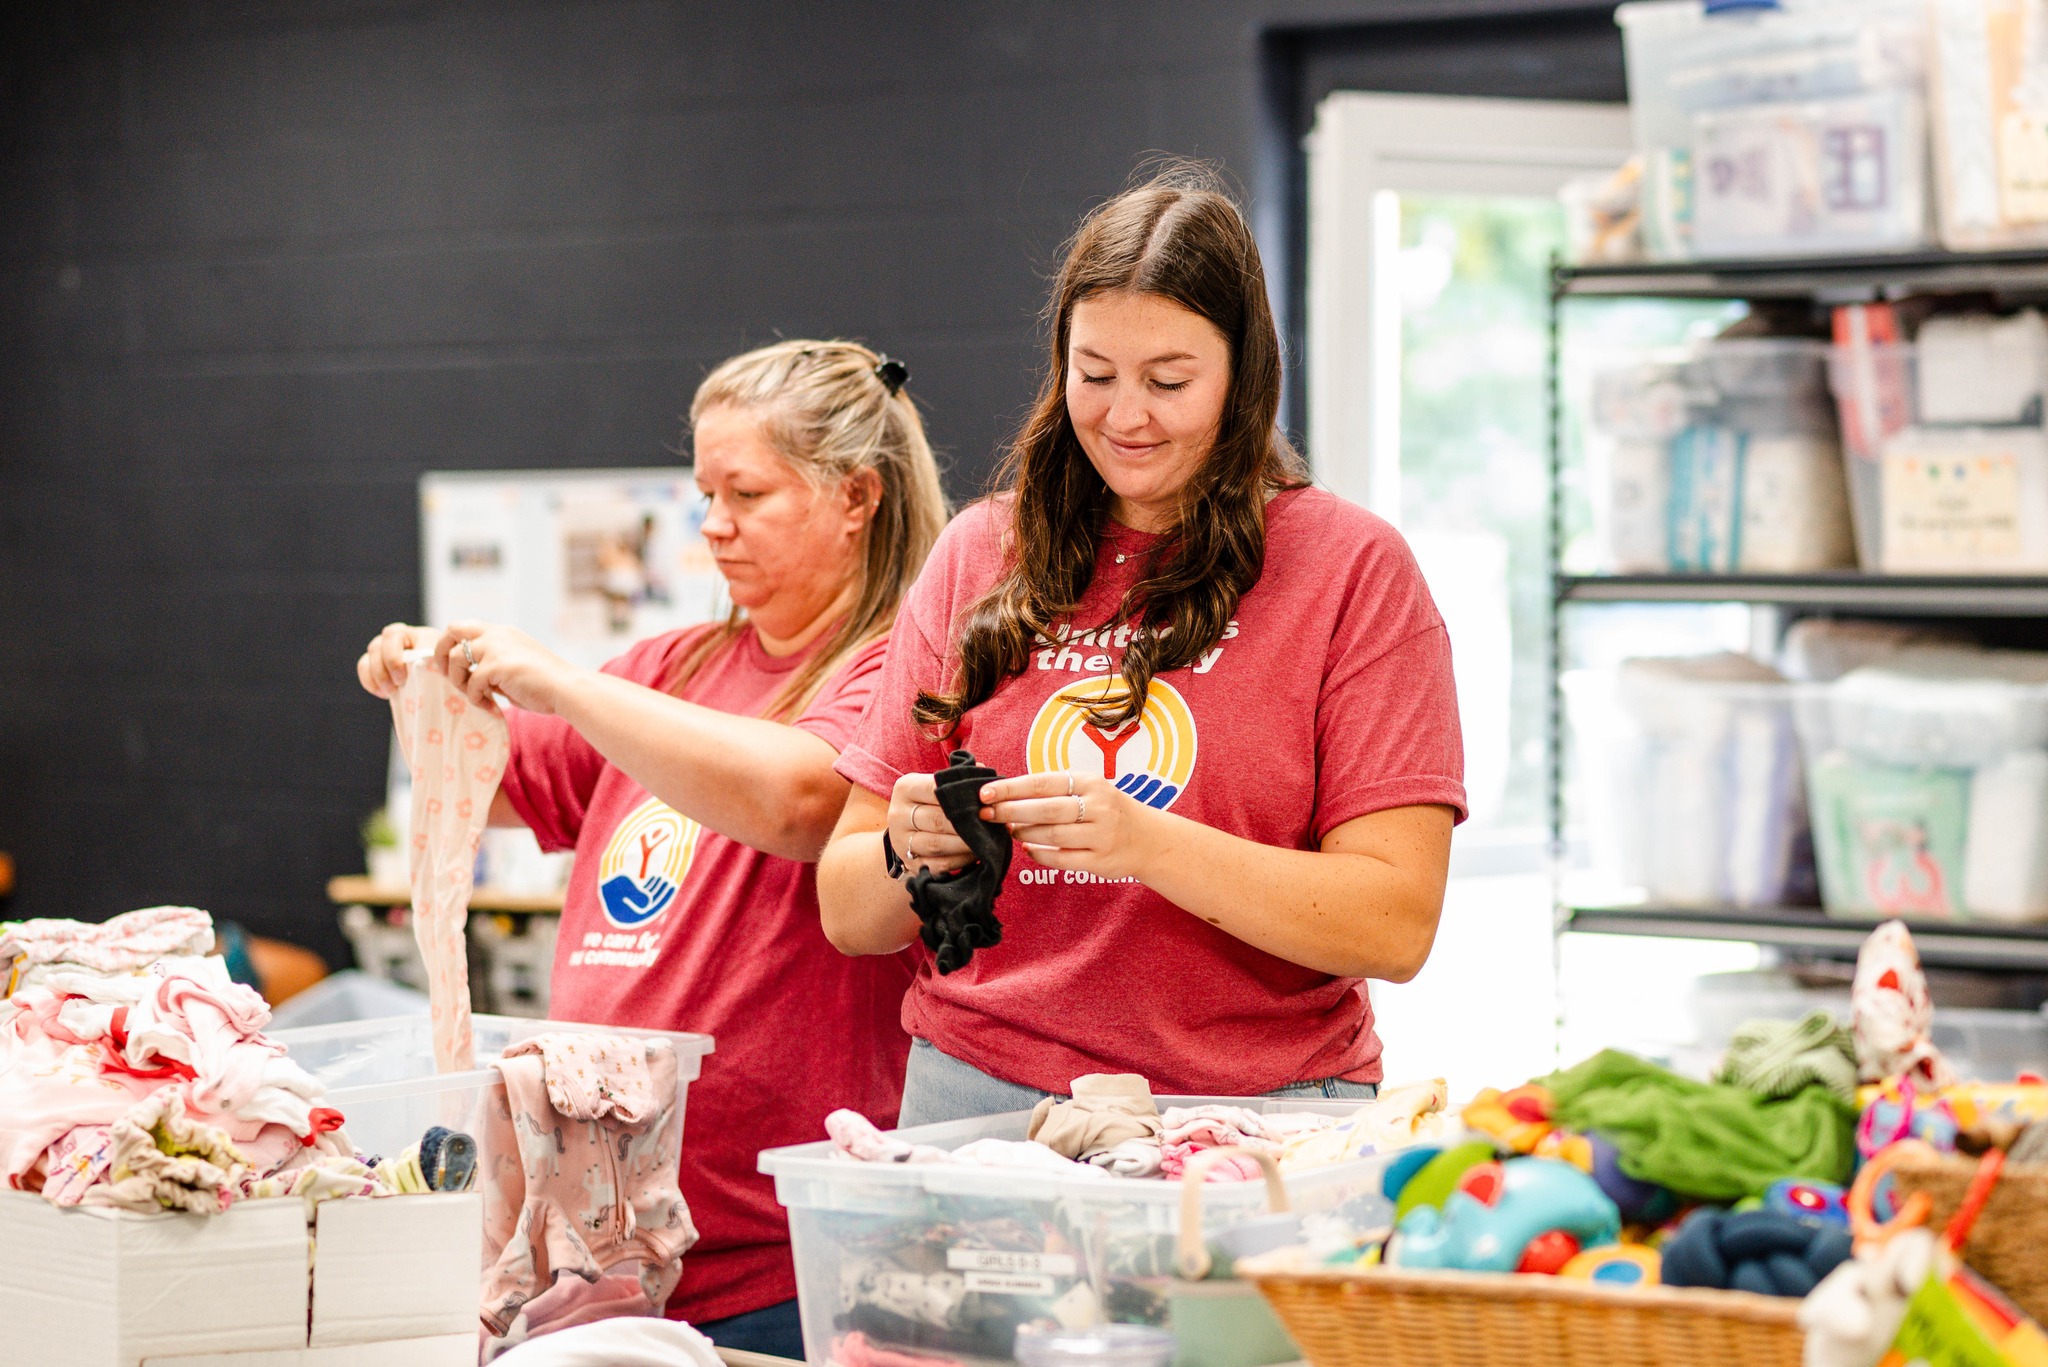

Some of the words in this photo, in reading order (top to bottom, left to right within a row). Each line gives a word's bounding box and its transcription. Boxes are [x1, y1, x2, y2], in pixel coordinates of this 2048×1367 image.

[1036, 645, 1113, 673] the
[1018, 869, 1060, 885] our
[603, 933, 637, 949] care
[977, 1253, 1014, 1268] GIRLS
